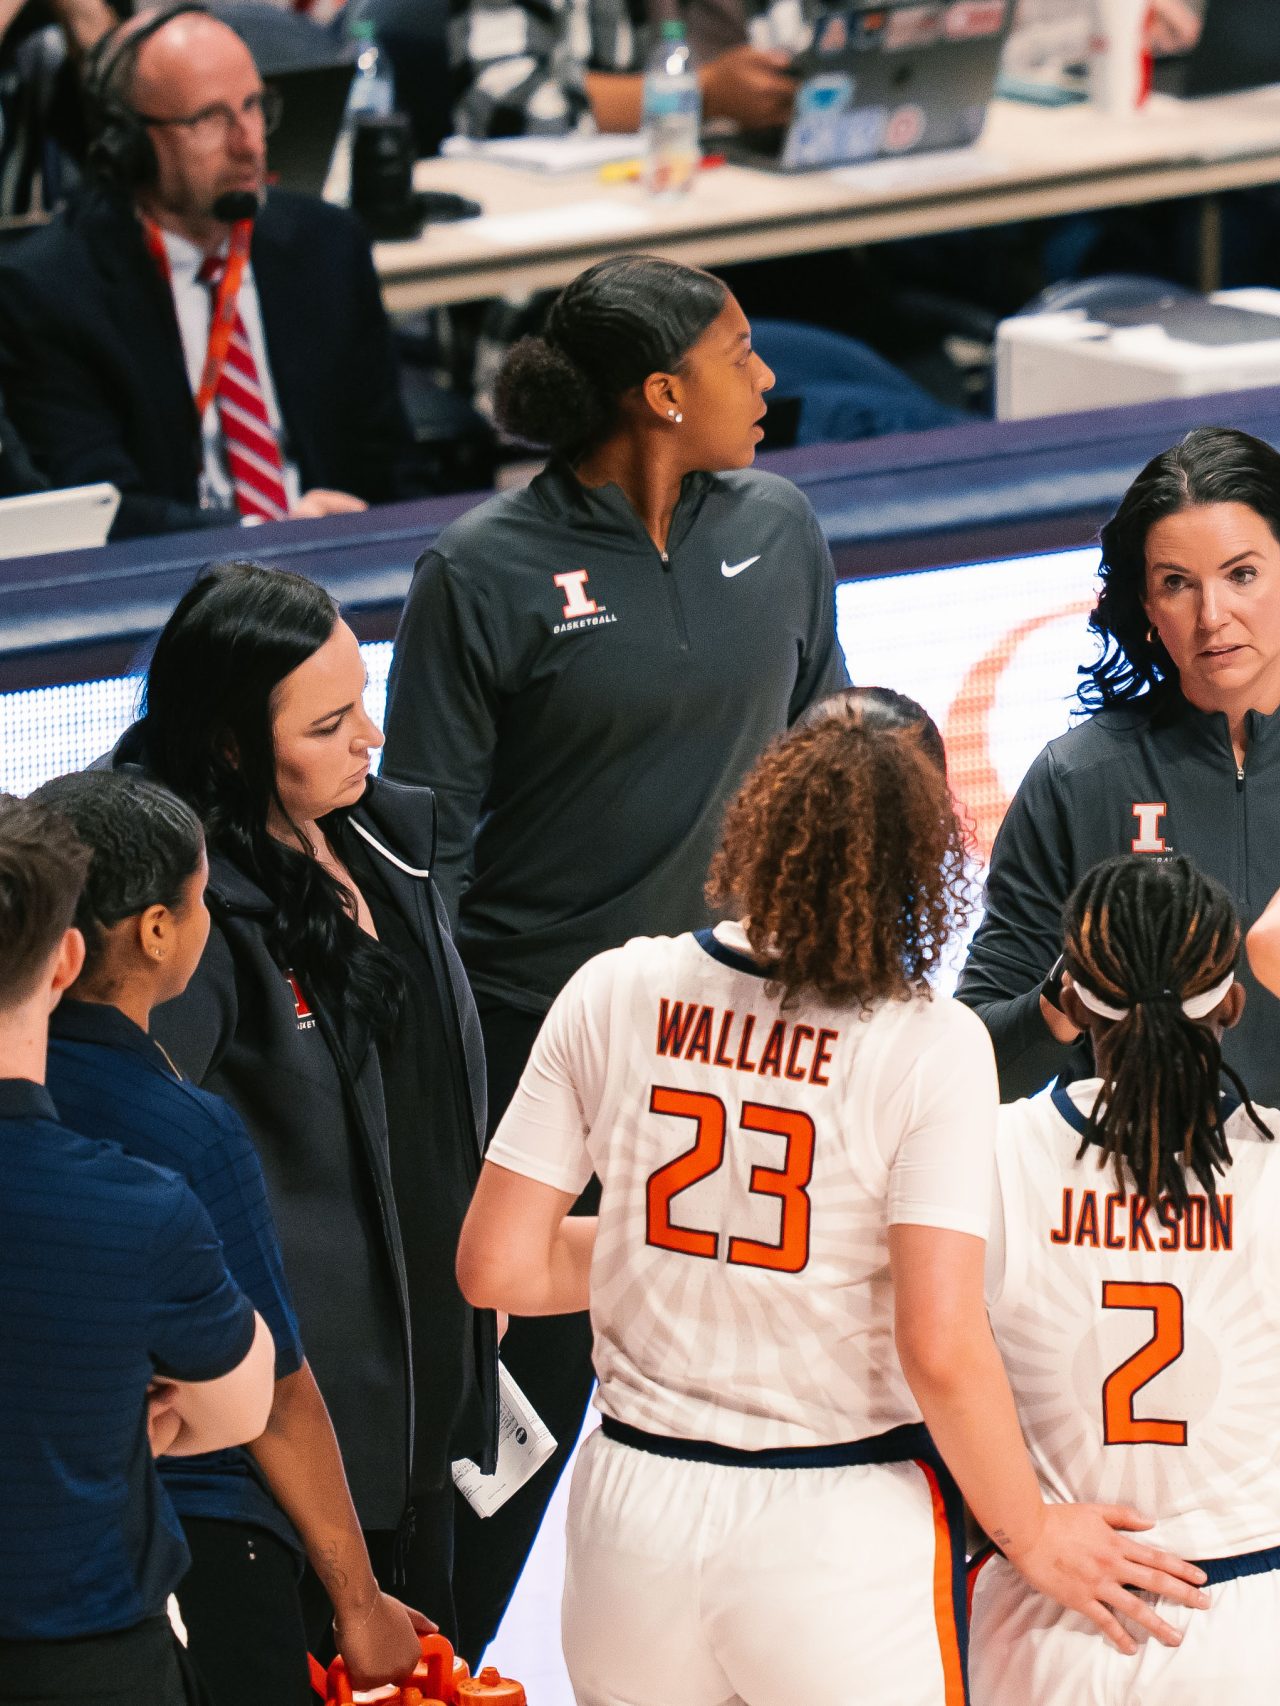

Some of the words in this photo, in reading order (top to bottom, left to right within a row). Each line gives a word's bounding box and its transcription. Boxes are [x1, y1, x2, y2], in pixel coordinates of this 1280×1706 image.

[553, 569, 598, 619] I
[553, 613, 618, 635] BASKETBALL
[1131, 803, 1167, 854] I
[656, 997, 839, 1087] WALLACE
[645, 1084, 816, 1274] 23
[1050, 1187, 1233, 1252] JACKSON
[1101, 1280, 1188, 1447] 2
